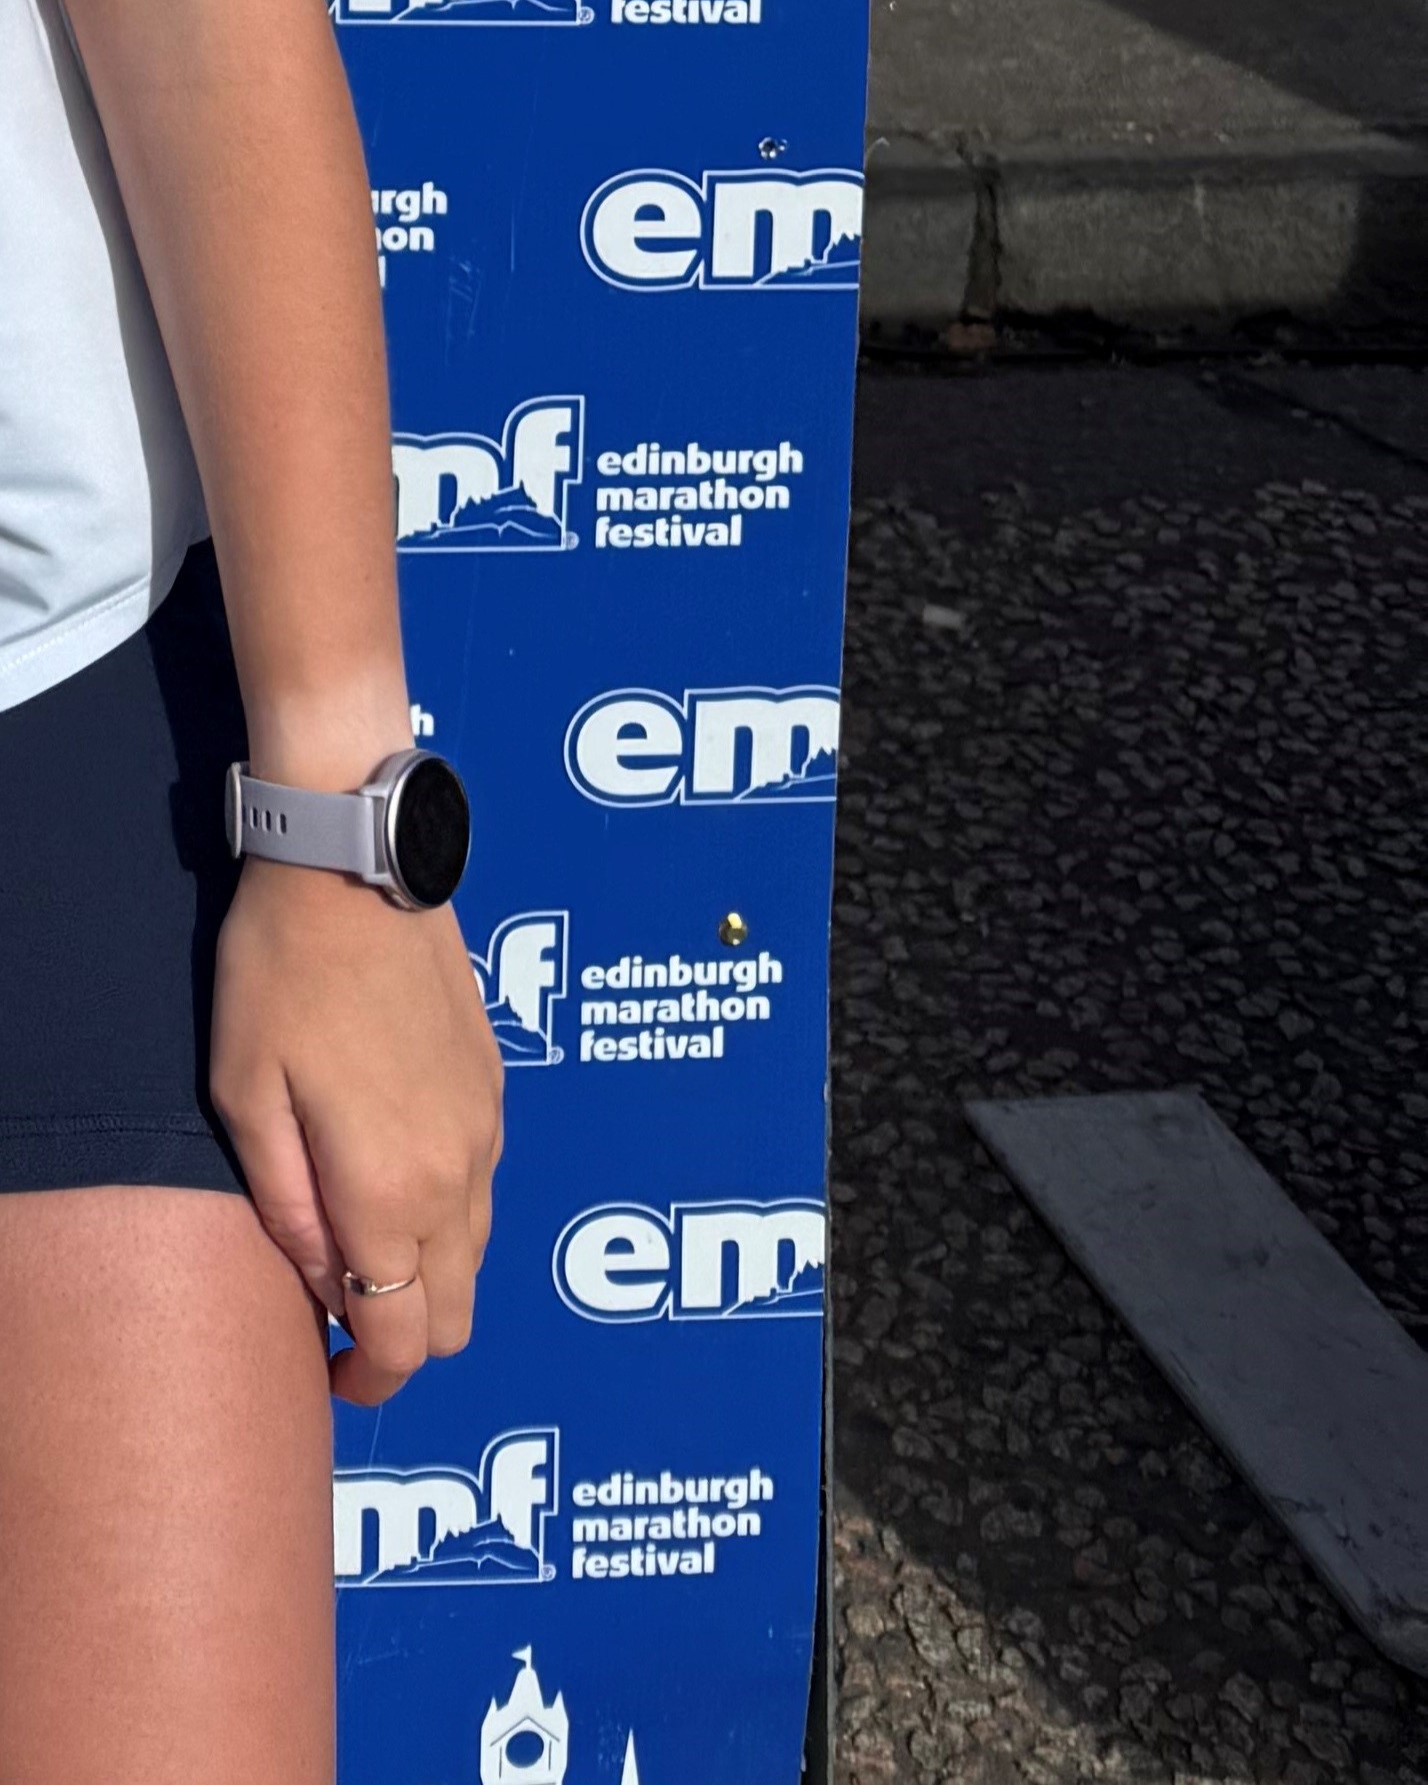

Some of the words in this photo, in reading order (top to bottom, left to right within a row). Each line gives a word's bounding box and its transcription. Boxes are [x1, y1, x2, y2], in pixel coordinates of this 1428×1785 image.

[596, 441, 804, 482] edinburgh
[596, 477, 790, 512] marathon
[595, 513, 742, 548] festival
[580, 951, 783, 993] edinburgh
[580, 989, 771, 1026] marathon
[580, 1025, 724, 1062] festival
[572, 1468, 774, 1510] edinburgh
[572, 1505, 761, 1543] marathon
[572, 1540, 715, 1579] festival
